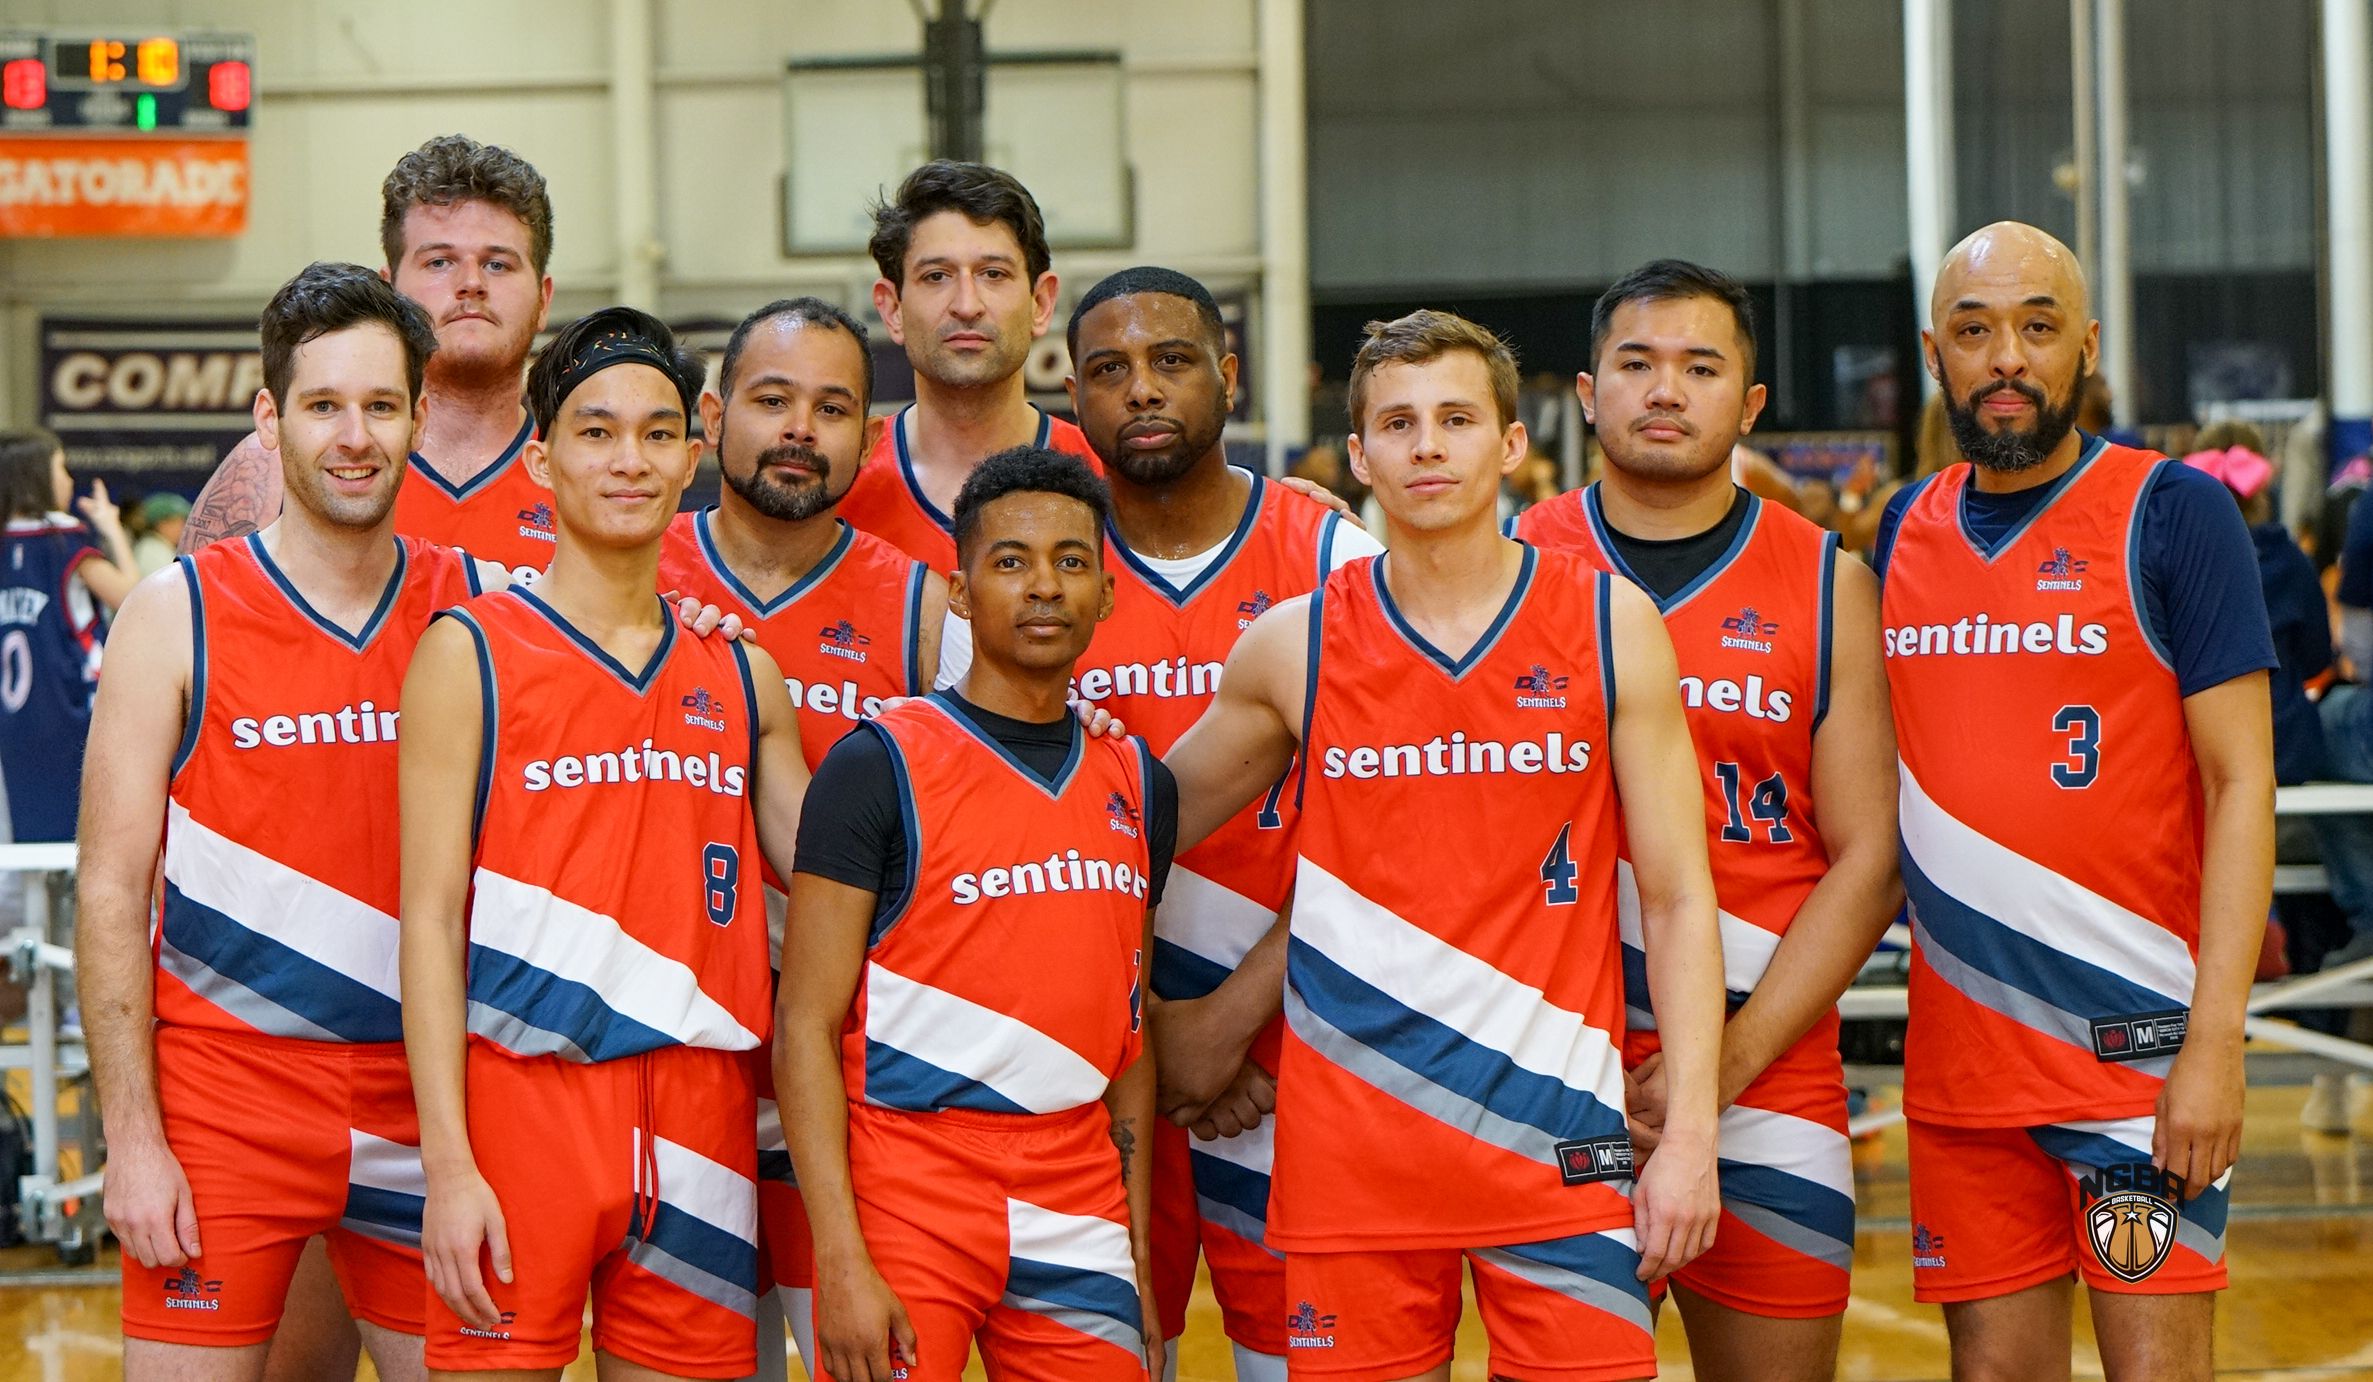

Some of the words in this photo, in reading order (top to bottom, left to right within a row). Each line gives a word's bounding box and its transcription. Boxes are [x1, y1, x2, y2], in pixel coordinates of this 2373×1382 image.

[2037, 579, 2082, 591] SENTINELS
[1722, 635, 1772, 654] SENTINELS
[1885, 612, 2108, 658] sentinels
[820, 643, 867, 664] SENTINELS
[1517, 696, 1566, 709] SENTINELS
[685, 713, 726, 732] SENTINELS
[1322, 730, 1591, 779] sentinels
[2050, 704, 2101, 790] 3
[523, 738, 745, 797] sentinels
[1715, 761, 1794, 843] 14
[1539, 820, 1578, 906] 4
[702, 841, 739, 928] 8
[2136, 1026, 2154, 1044] M
[1598, 1149, 1613, 1166] M
[166, 1296, 219, 1311] SENTINELS
[1289, 1335, 1335, 1348] SENTINELS
